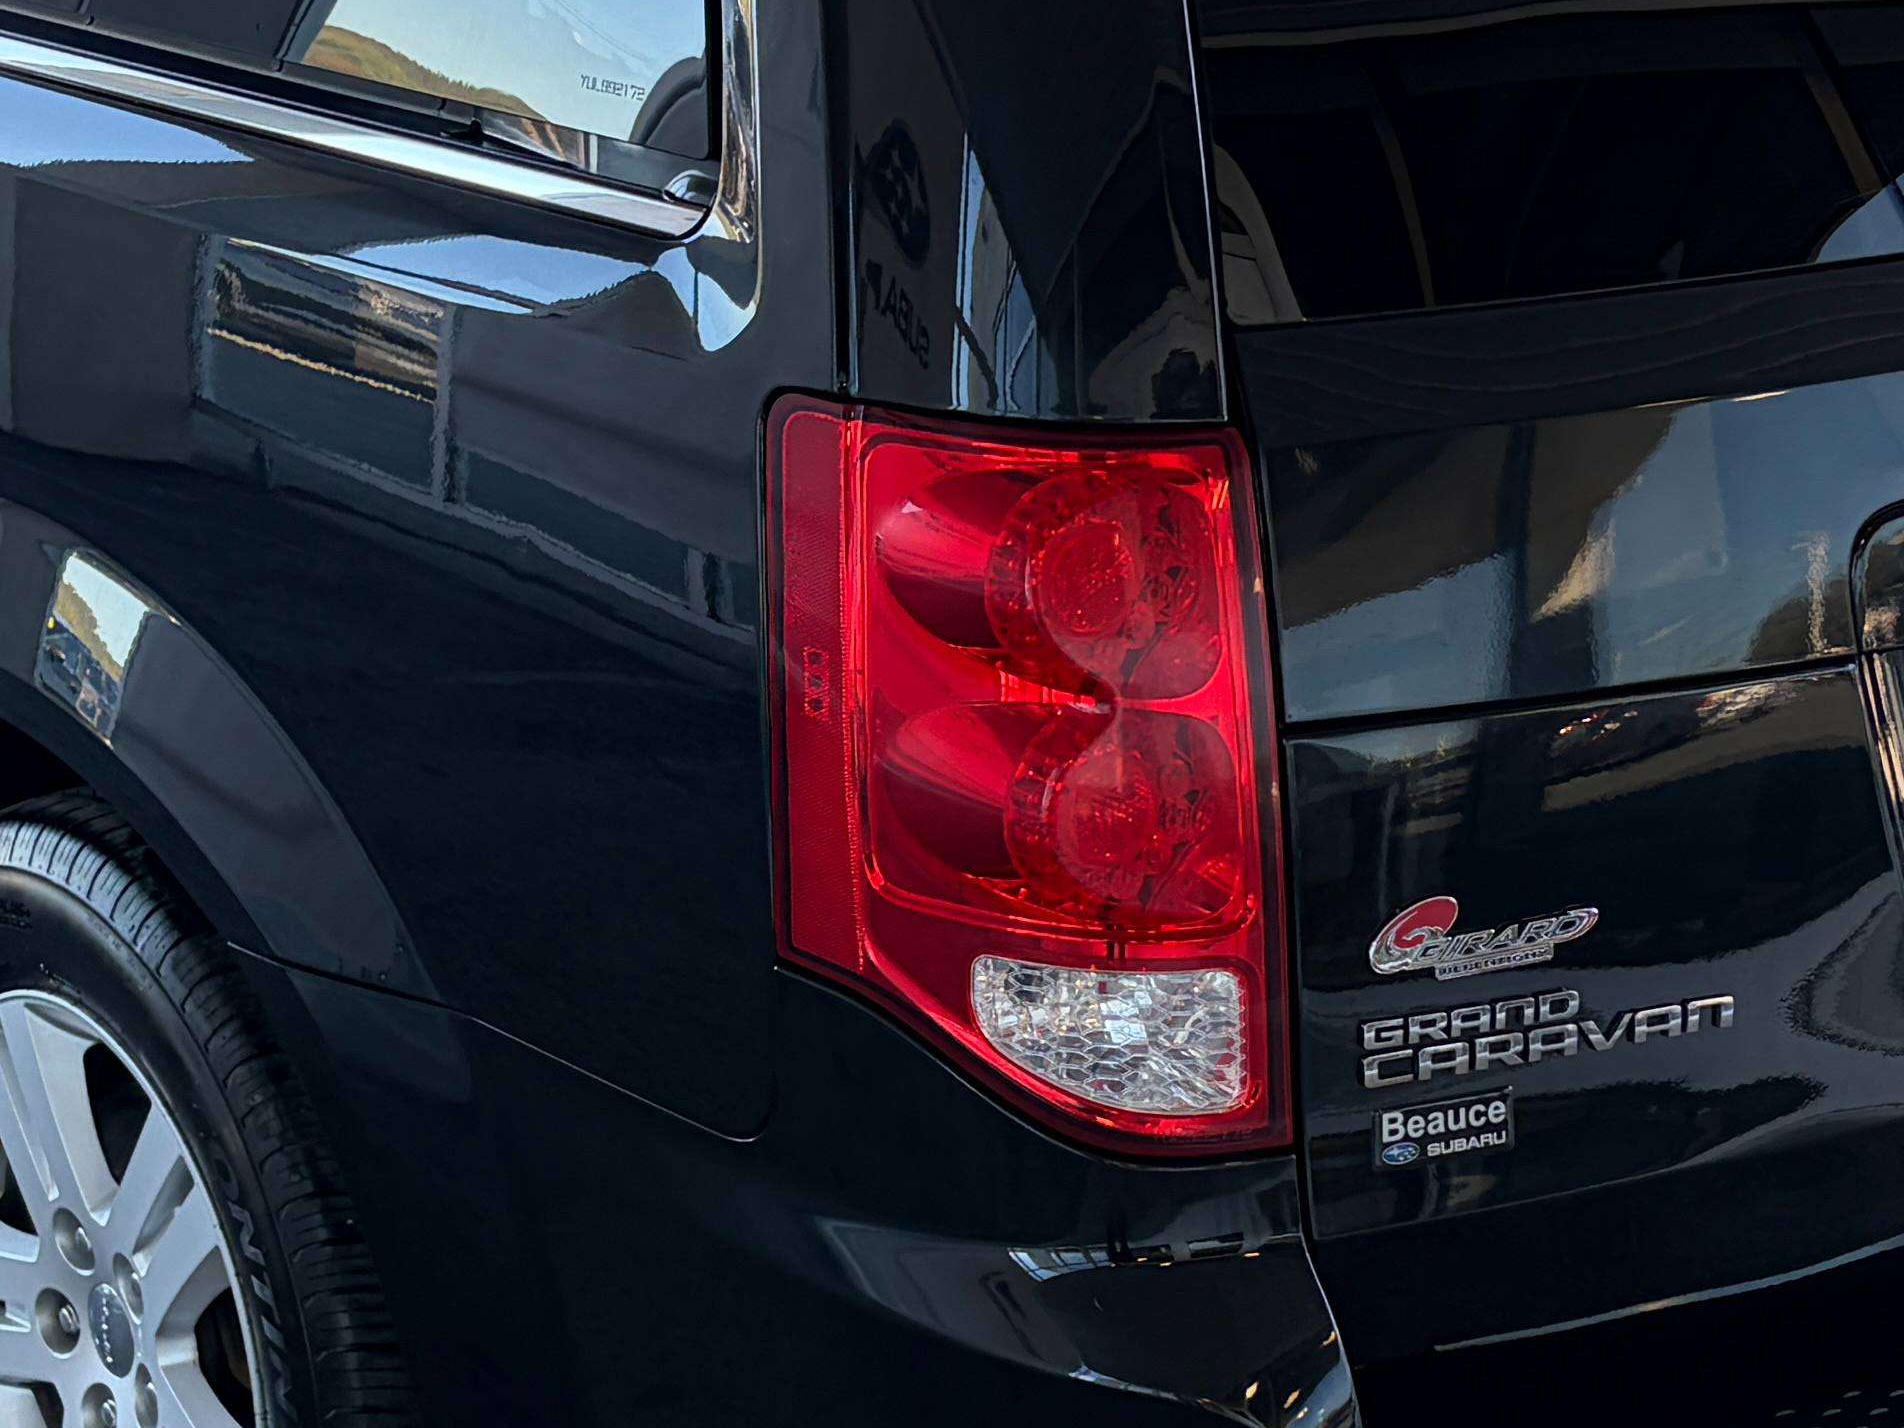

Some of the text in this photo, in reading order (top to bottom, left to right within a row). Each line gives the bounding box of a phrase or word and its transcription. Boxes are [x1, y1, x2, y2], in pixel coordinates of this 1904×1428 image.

[1363, 988, 1581, 1051] GRAND
[1363, 994, 1736, 1090] CARAVAN
[1382, 1097, 1507, 1144] Beauce
[1426, 1129, 1507, 1158] SUBARU
